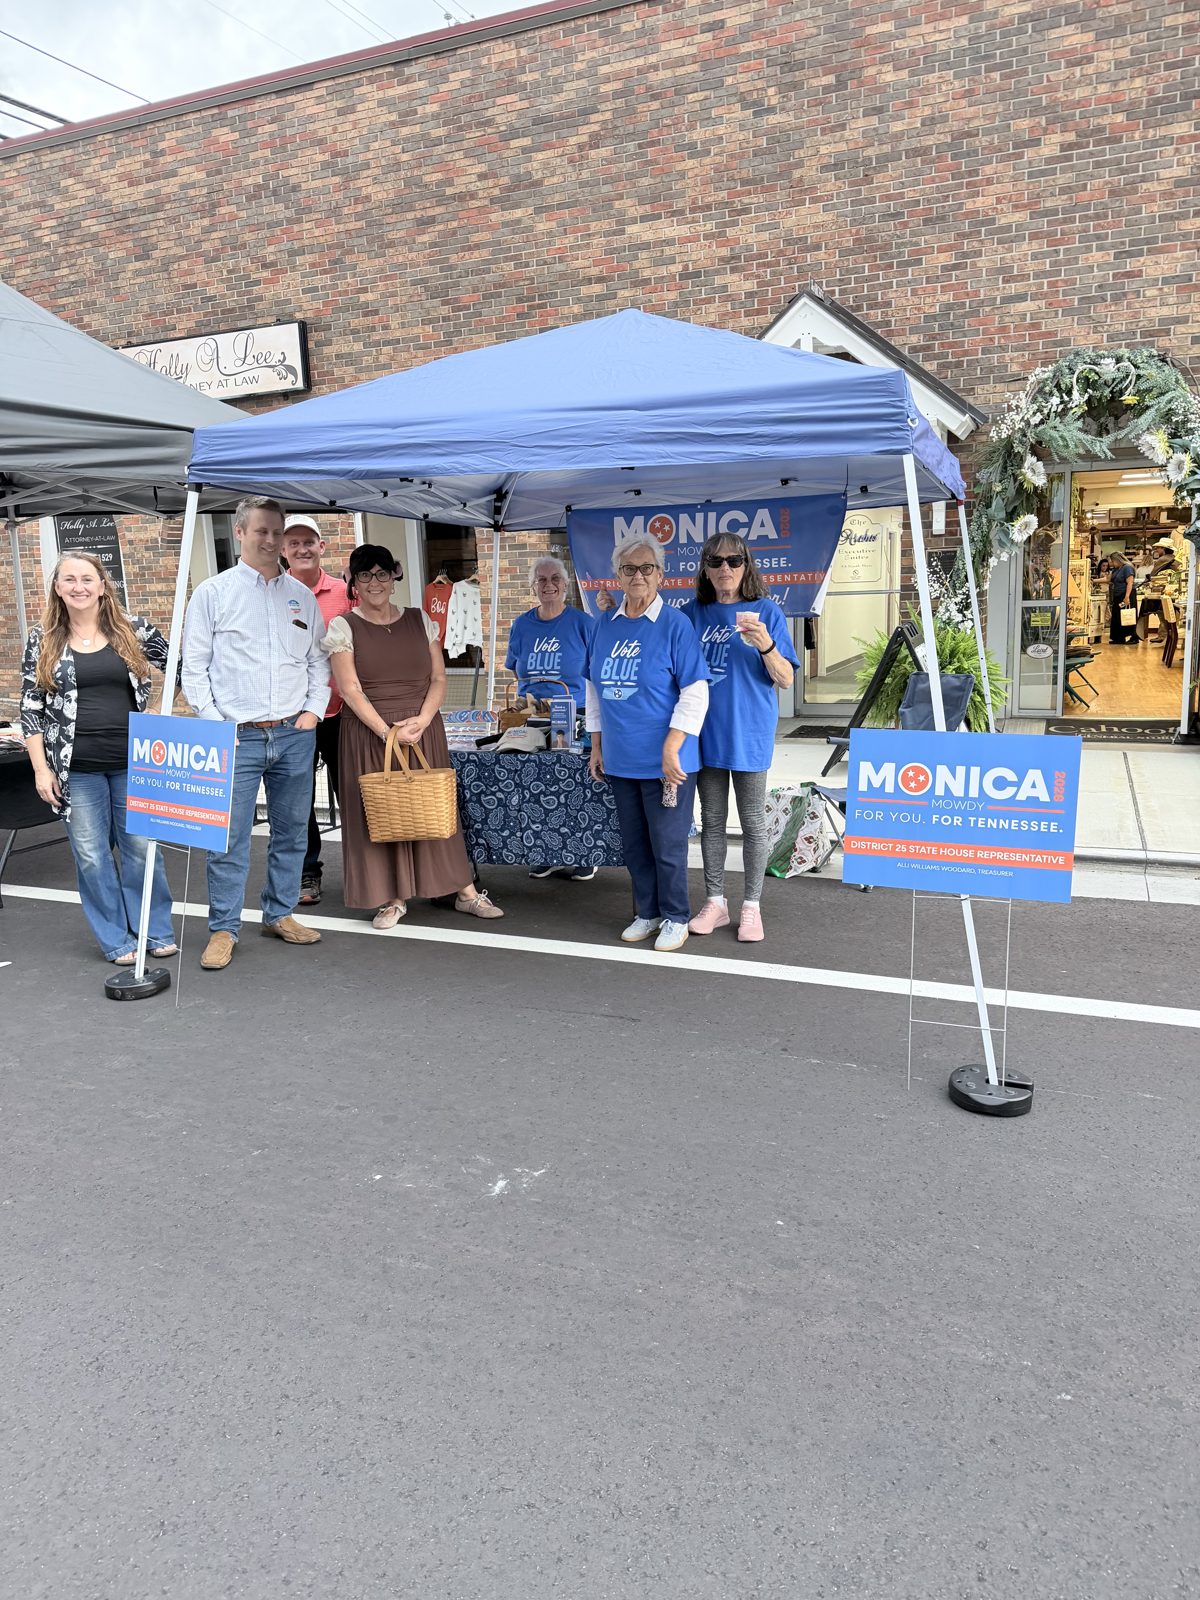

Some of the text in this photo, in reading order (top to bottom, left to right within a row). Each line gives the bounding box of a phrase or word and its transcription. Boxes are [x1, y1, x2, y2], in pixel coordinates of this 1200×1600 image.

[216, 378, 230, 389] AT
[234, 374, 260, 387] LAW
[60, 517, 86, 535] Holly
[99, 517, 115, 528] Lee
[614, 508, 779, 546] MONICA
[702, 624, 731, 643] Vote
[533, 636, 560, 652] Vote
[611, 640, 641, 658] Vote
[527, 652, 562, 670] BLUE
[700, 642, 730, 667] LUE
[600, 657, 641, 680] BLUE
[1048, 725, 1183, 735] Cahoot
[133, 737, 221, 773] MONICA
[166, 768, 191, 779] MOWDY
[858, 761, 1051, 802] MONICA
[132, 775, 226, 798] FOR YOU. FOR TENNESSEE.
[931, 799, 986, 811] MOWDY
[855, 809, 1064, 833] FOR YOU. FOR TENNESSEE.
[850, 840, 1065, 865] DISTRICT 25 STATE HOUSE REPRESENTATIVE
[910, 862, 941, 871] WILLIAMS
[977, 868, 1014, 877] TREASURER
